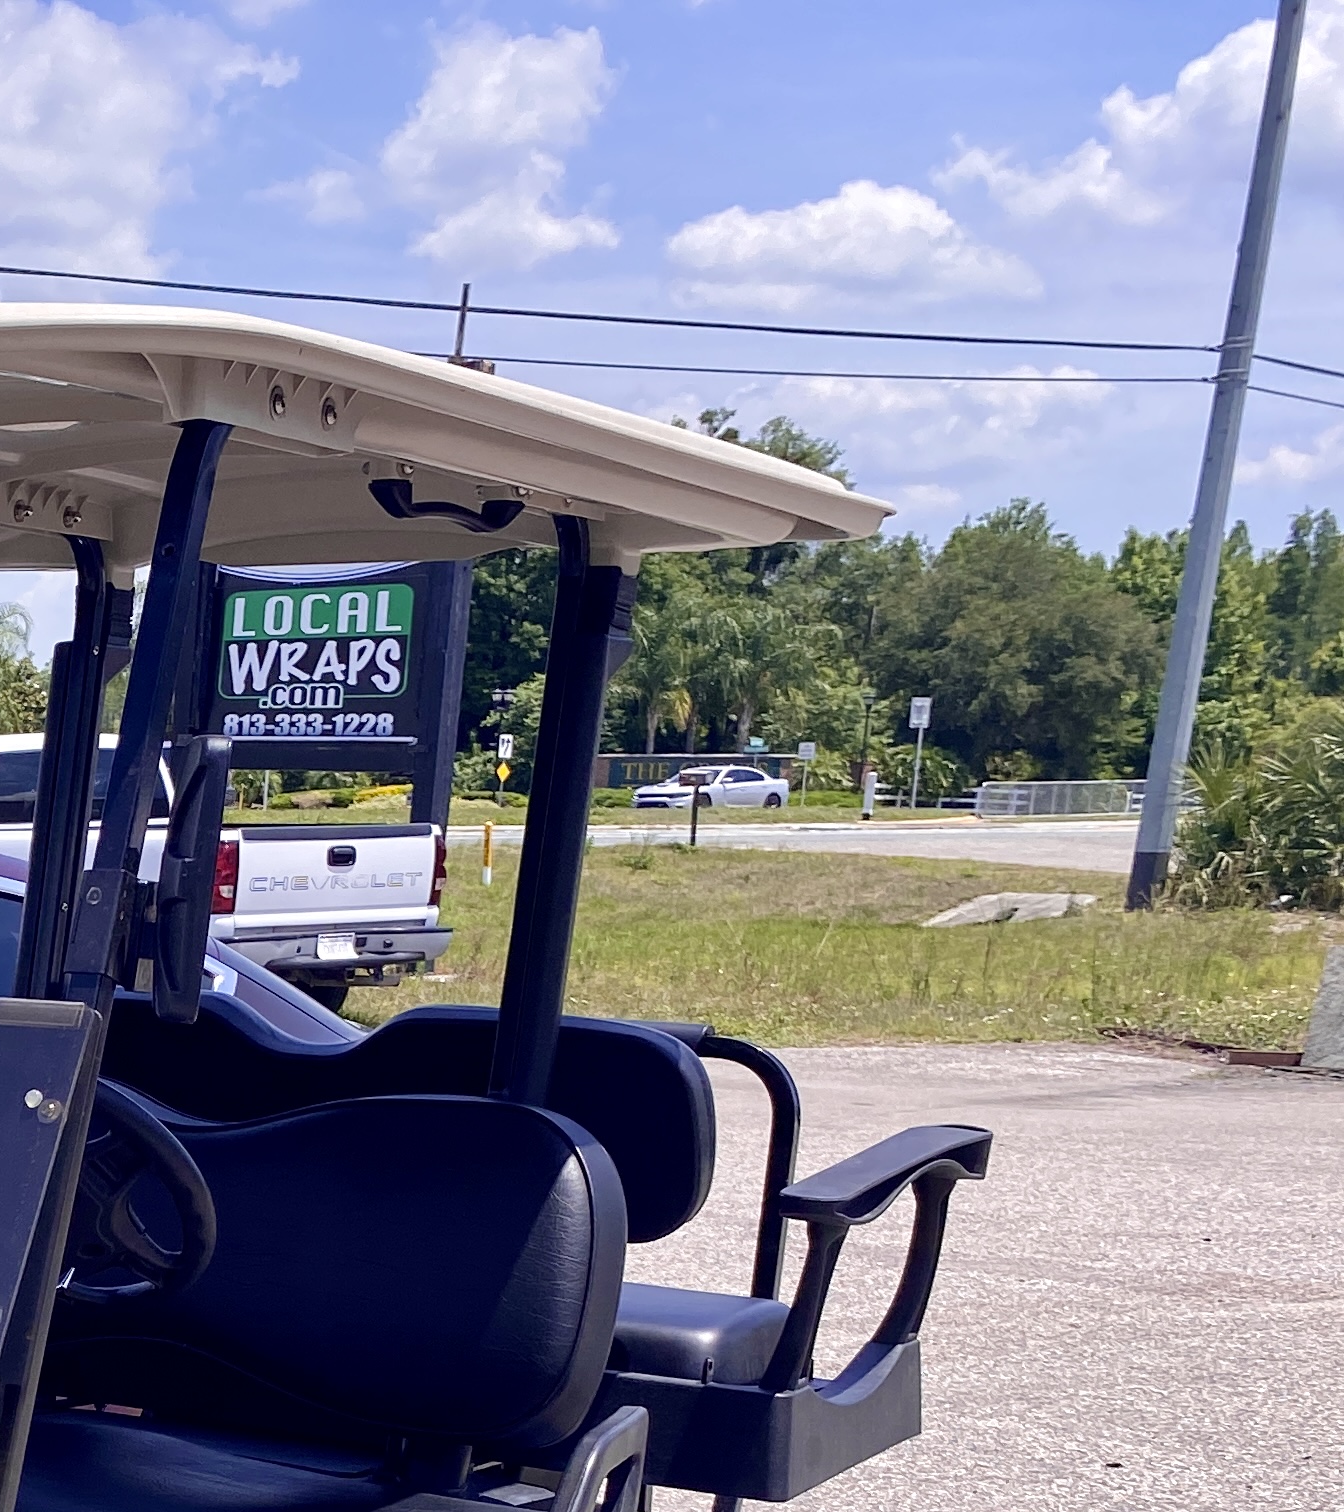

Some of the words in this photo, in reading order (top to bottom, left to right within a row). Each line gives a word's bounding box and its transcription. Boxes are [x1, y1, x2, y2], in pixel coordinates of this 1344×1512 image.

[233, 591, 402, 637] LOCAL
[228, 638, 400, 694] WRAPS
[259, 683, 343, 708] .com
[223, 713, 394, 736] 813-333-1228
[621, 762, 669, 780] THE
[249, 872, 422, 891] CHEVROLET
